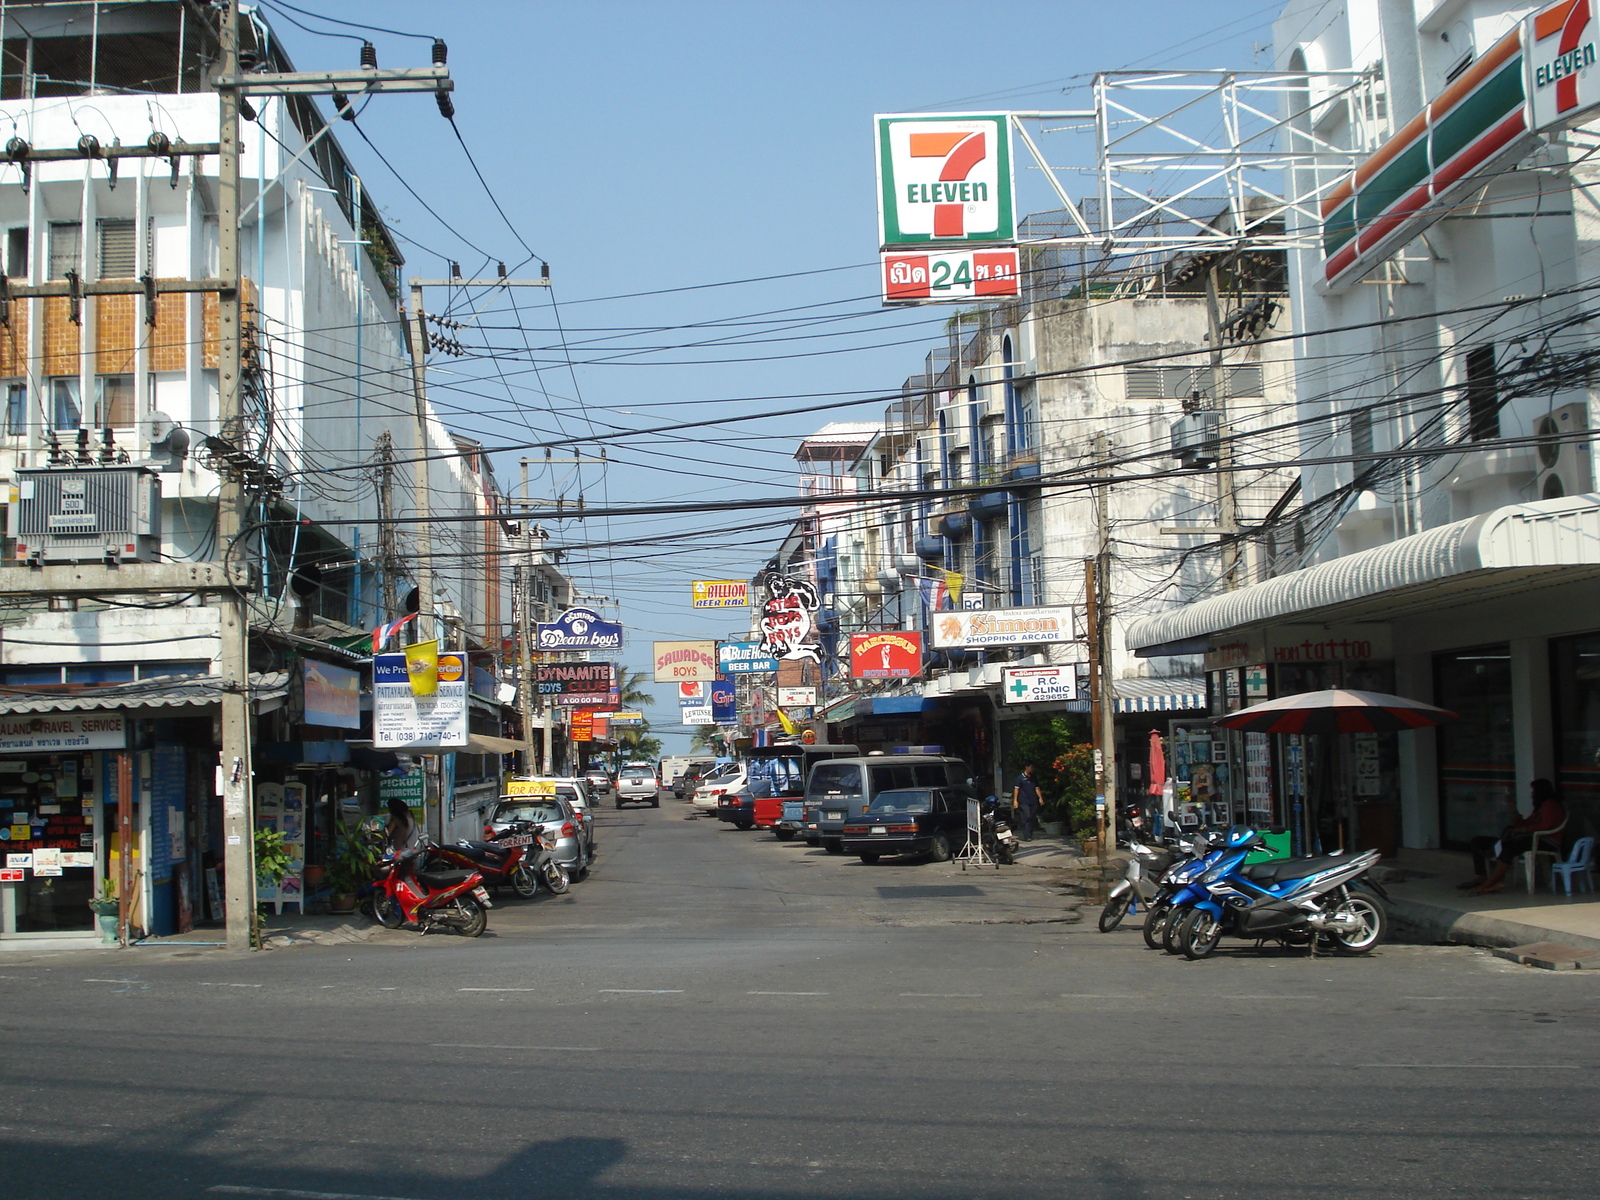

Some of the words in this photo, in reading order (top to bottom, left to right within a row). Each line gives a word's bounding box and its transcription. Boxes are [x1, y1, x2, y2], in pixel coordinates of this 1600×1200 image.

[932, 260, 972, 291] 24
[707, 584, 746, 598] BILLION
[769, 595, 800, 612] STAR
[768, 611, 802, 628] BOYS
[969, 614, 1059, 636] Simon
[768, 627, 801, 643] BOYS
[966, 634, 1017, 643] SHOPPING
[1021, 633, 1060, 641] ARCADE
[657, 649, 713, 670] SAWADEE
[376, 666, 391, 675] We
[392, 665, 408, 675] Pre
[673, 666, 697, 676] BOYS
[728, 662, 749, 671] BEER
[753, 661, 770, 669] BAR
[537, 666, 608, 681] DYNAMITE
[863, 669, 888, 677] BOYS
[1038, 677, 1060, 685] R.C.
[440, 685, 463, 698] SERVICE
[538, 683, 561, 693] BOYS
[568, 681, 608, 692] CLUB
[1032, 686, 1070, 694] CLINIC
[1034, 693, 1068, 701] 429655
[81, 719, 122, 732] SERVICE
[379, 731, 393, 741] Tel.
[396, 731, 415, 741] (038)
[420, 731, 461, 740] 710-740-1
[380, 778, 421, 787] PICKUP
[380, 788, 422, 797] MOTORCYCLE
[509, 786, 525, 795] FOR
[527, 785, 551, 795] RENT
[500, 839, 513, 848] FOR
[513, 836, 532, 846] RENT
